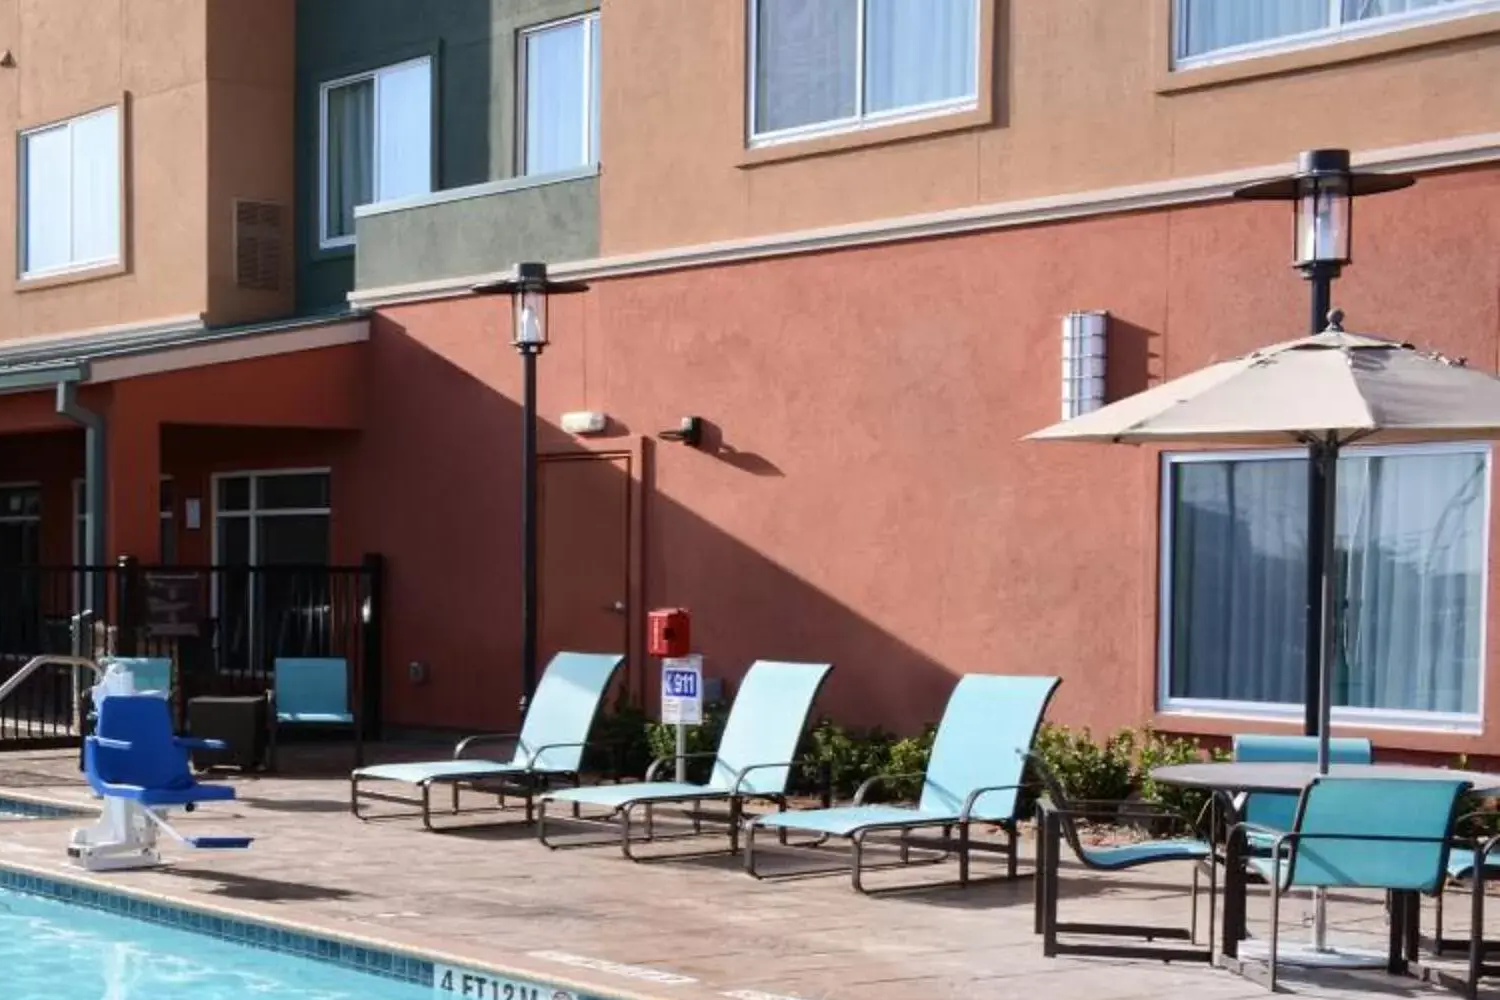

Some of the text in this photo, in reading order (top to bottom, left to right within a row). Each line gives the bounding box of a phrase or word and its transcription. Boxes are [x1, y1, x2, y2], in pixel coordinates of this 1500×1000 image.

[675, 673, 694, 693] 911
[440, 970, 453, 991] 4
[462, 973, 487, 999] FT
